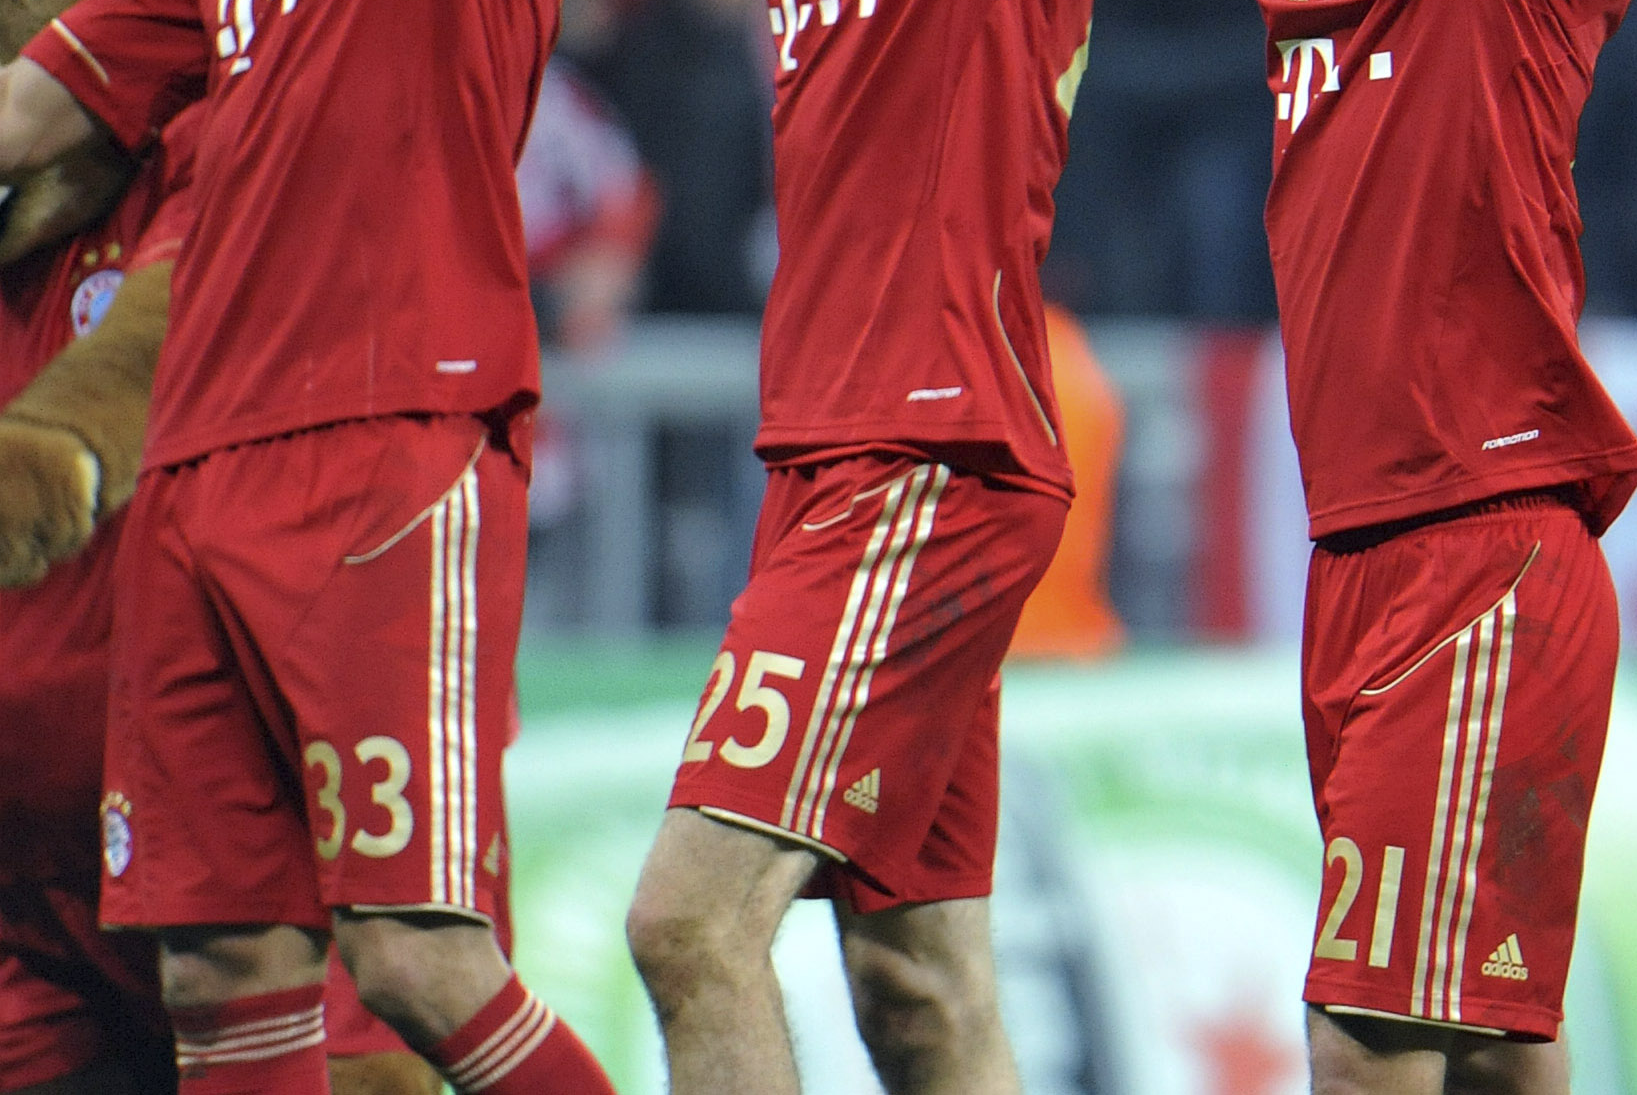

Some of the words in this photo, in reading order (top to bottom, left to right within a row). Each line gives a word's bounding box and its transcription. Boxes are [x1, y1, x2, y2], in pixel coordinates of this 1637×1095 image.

[682, 650, 806, 769] 25
[303, 735, 415, 861] 33
[1314, 836, 1406, 969] 21
[1481, 960, 1529, 981] adidas
